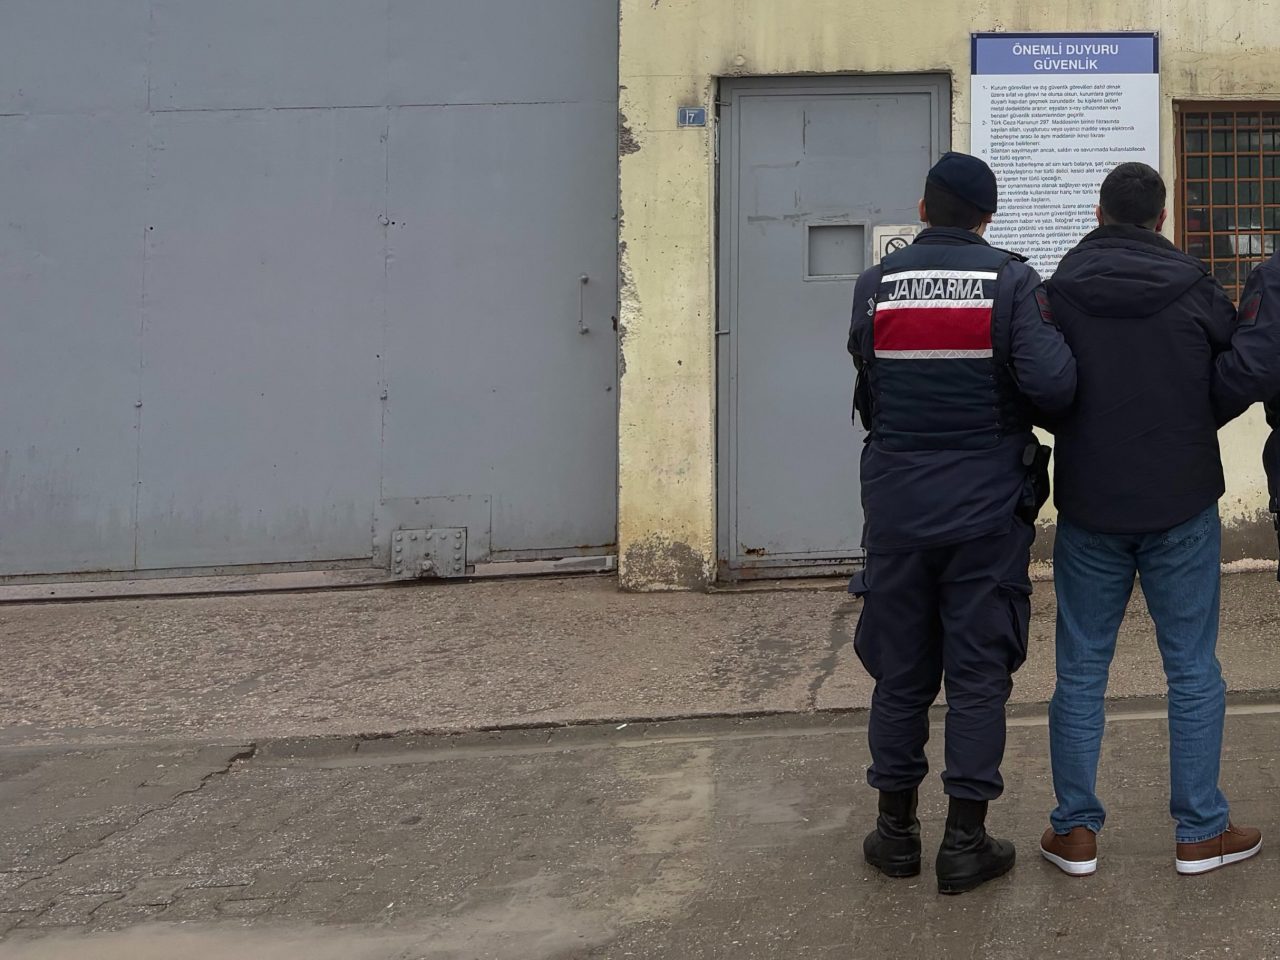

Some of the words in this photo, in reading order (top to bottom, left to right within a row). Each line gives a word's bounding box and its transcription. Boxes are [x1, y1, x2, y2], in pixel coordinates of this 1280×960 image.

[1012, 42, 1062, 56] ÖNEMLİ
[1066, 44, 1119, 55] DUYURU
[1033, 56, 1098, 70] GÜVENLİK
[888, 278, 985, 301] JANDARMA
